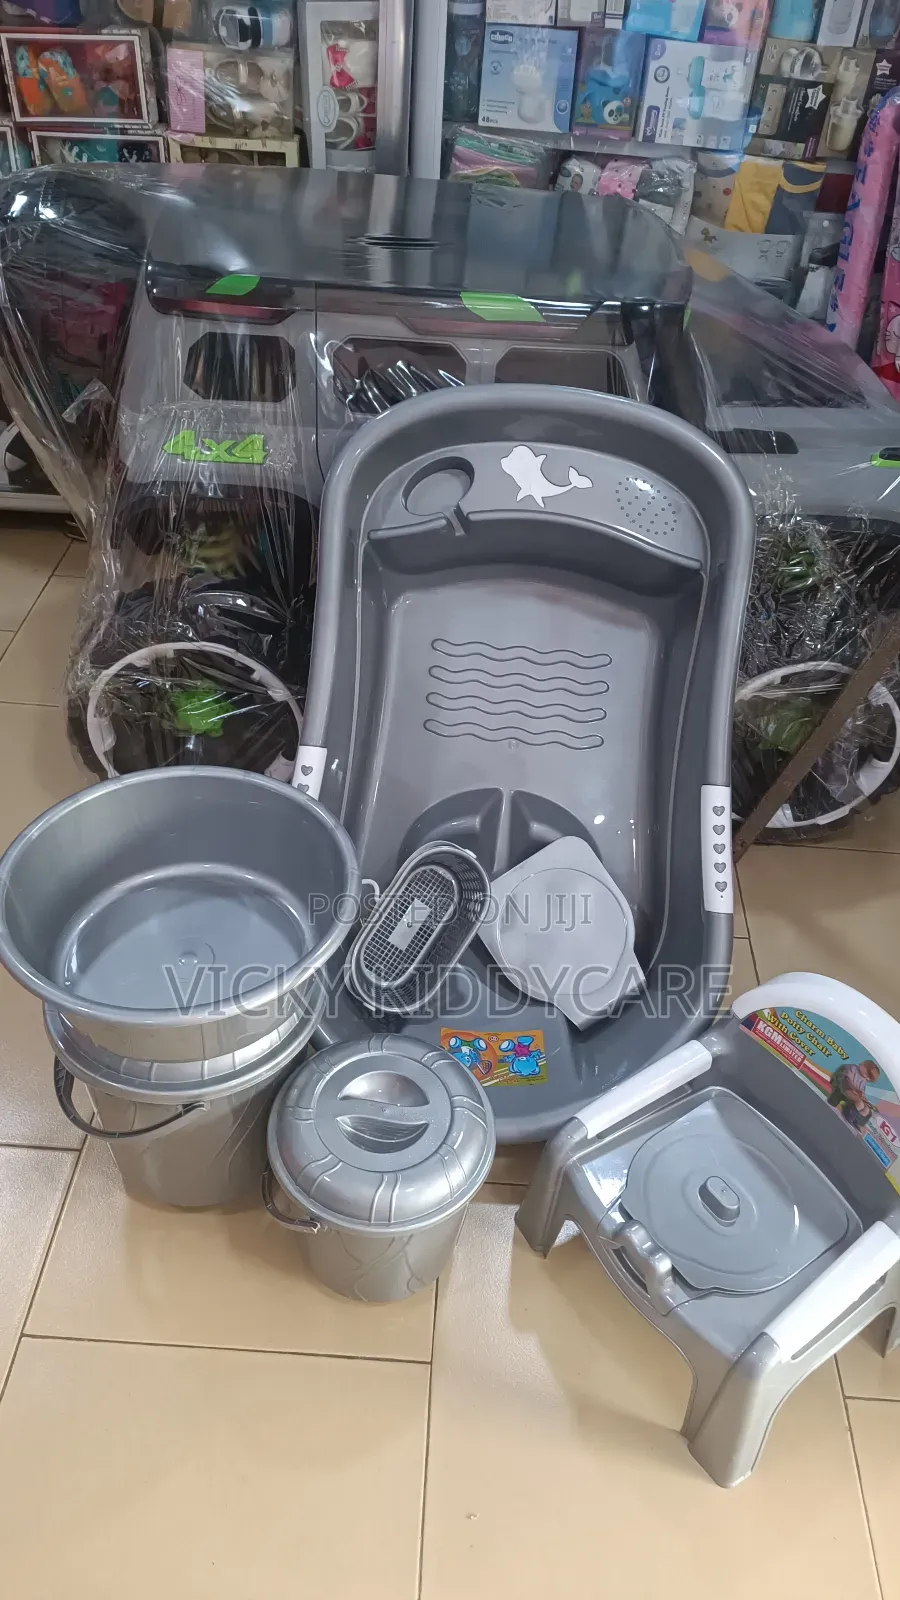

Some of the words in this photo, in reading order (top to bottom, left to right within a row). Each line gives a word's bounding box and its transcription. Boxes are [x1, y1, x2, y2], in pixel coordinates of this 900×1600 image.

[162, 430, 268, 465] 4x4
[756, 1020, 783, 1046] KGM
[767, 1012, 789, 1034] With
[788, 1030, 816, 1057] Cover
[780, 1011, 806, 1035] Potty
[806, 1031, 832, 1058] Chair
[794, 1009, 826, 1040] Charm
[826, 1034, 850, 1060] Baby
